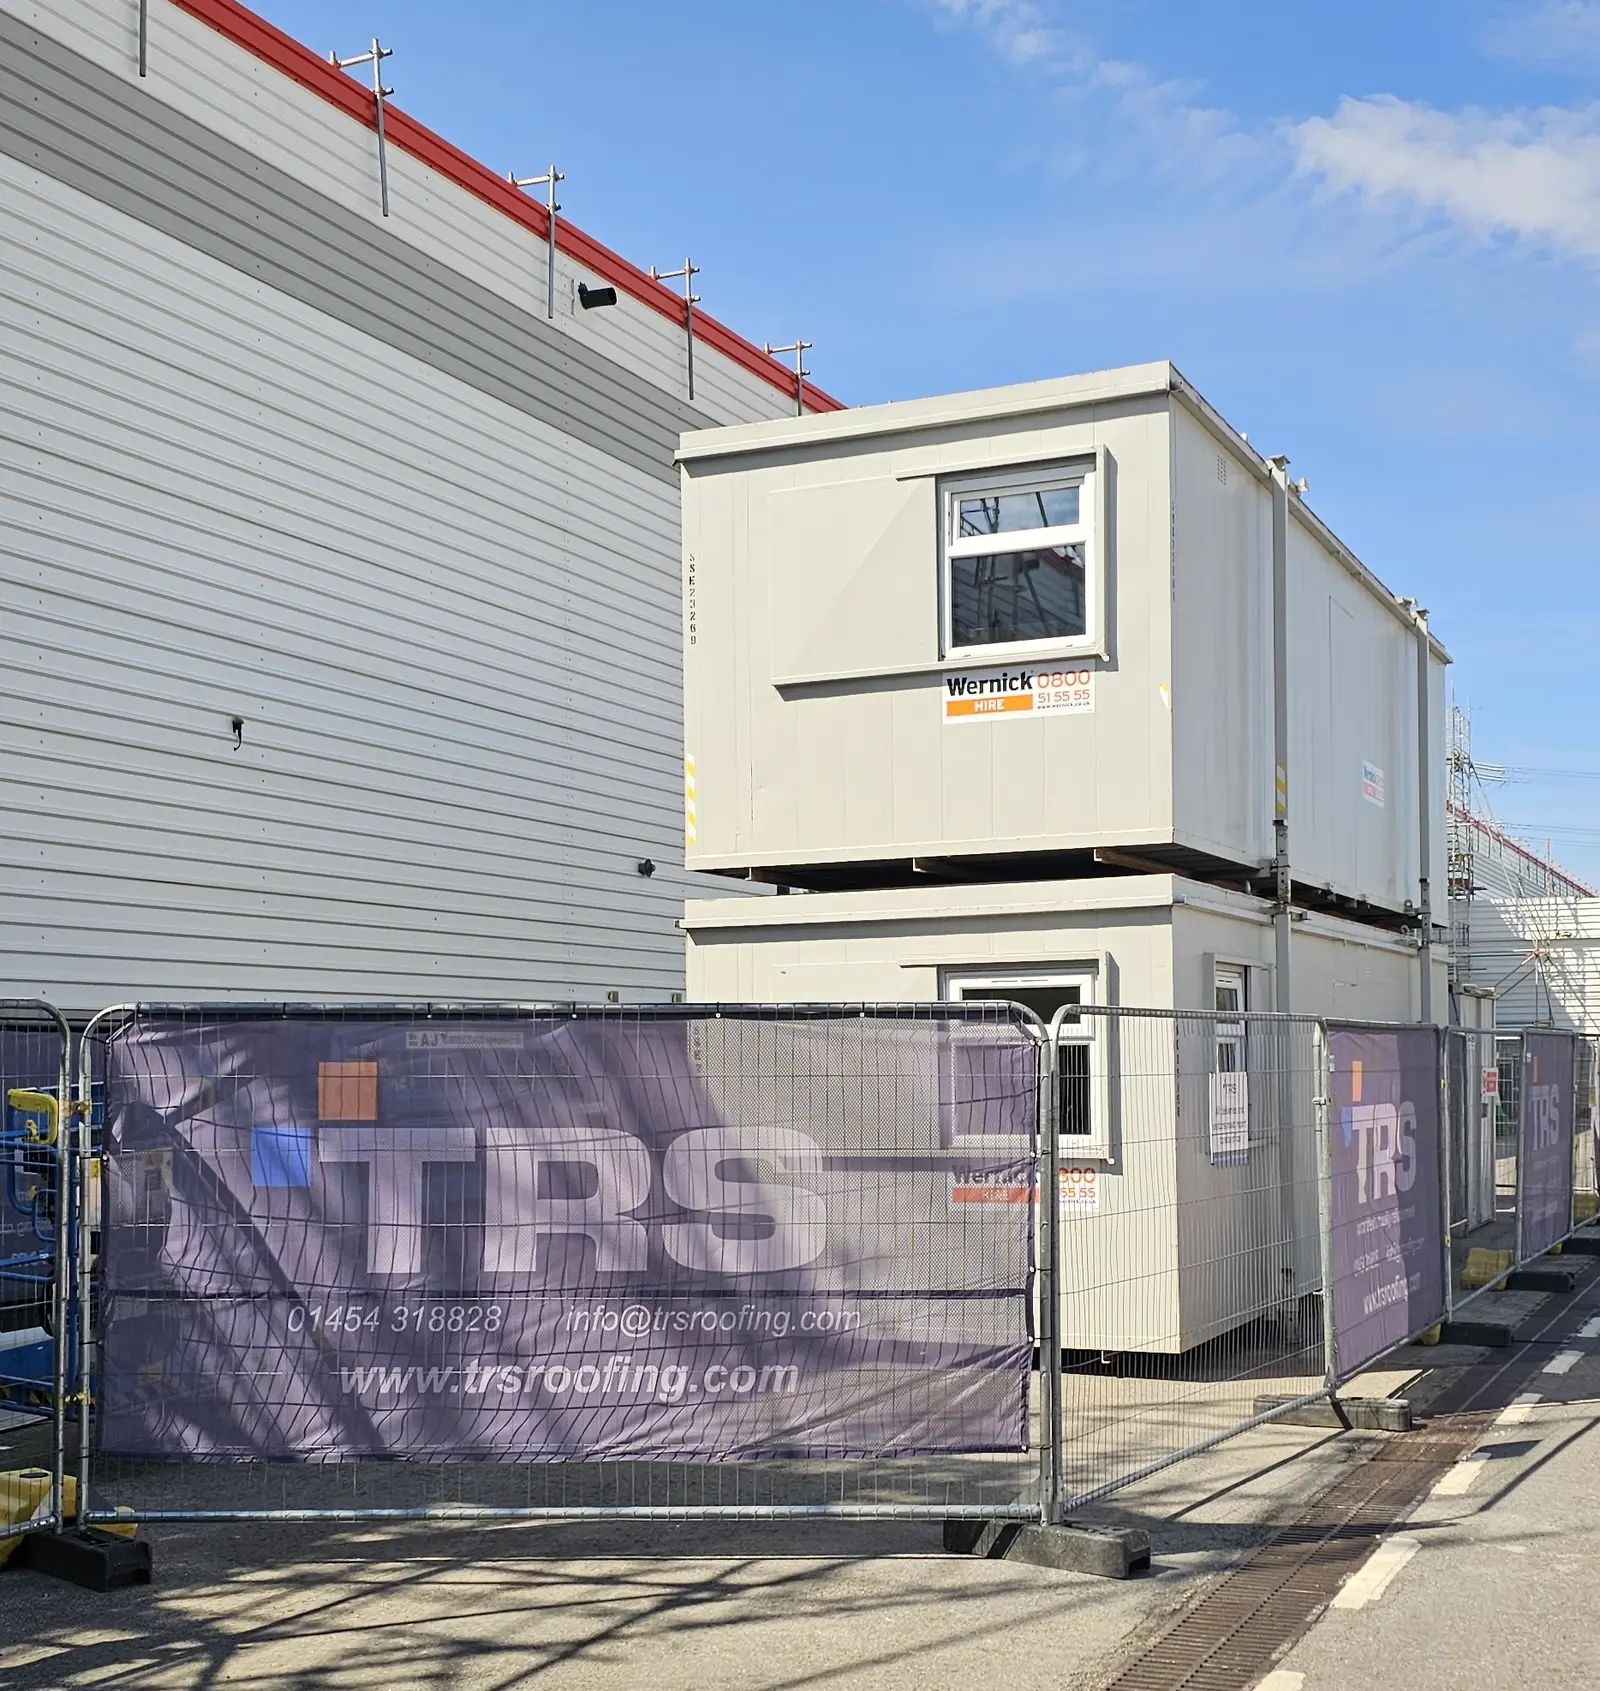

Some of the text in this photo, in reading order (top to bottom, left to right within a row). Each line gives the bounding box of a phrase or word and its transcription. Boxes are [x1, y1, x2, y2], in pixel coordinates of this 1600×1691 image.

[688, 552, 697, 645] SSE23269
[946, 671, 1032, 696] Wernick
[1037, 669, 1091, 689] 0800
[1038, 688, 1090, 704] 51 55 55
[974, 698, 1005, 712] HIRE
[1532, 1084, 1560, 1150] TRS
[1352, 1101, 1417, 1204] TRS
[318, 1126, 827, 1273] TRS
[287, 1305, 502, 1332] 01454 318828
[565, 1304, 861, 1338] info@trsroofing.com
[340, 1356, 799, 1402] www.trsroofing.com
